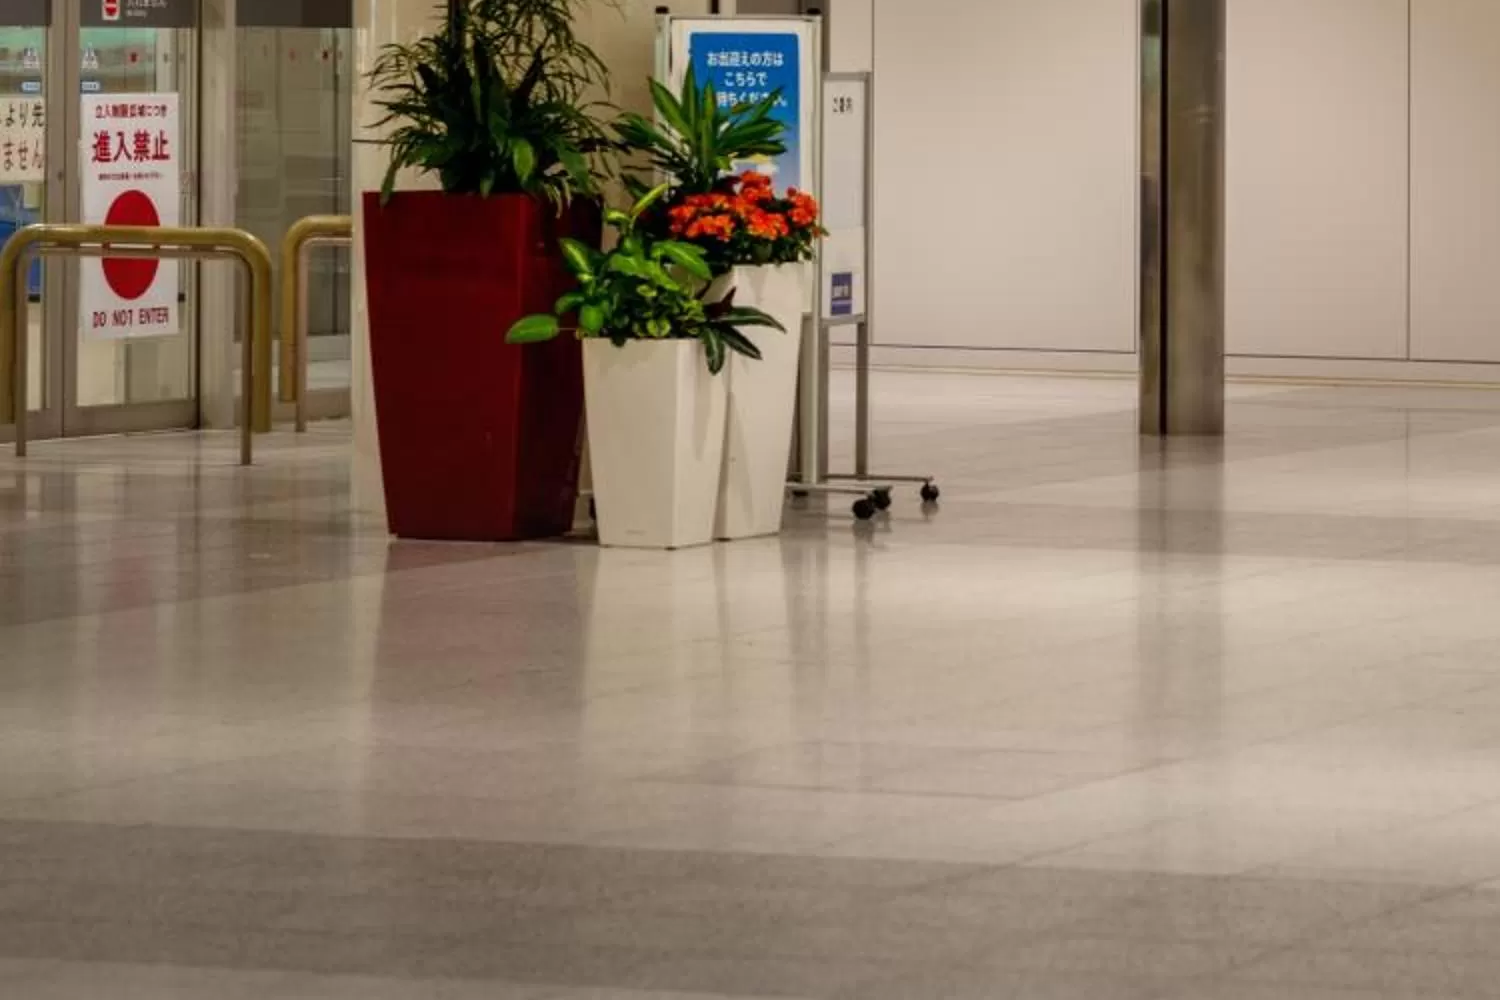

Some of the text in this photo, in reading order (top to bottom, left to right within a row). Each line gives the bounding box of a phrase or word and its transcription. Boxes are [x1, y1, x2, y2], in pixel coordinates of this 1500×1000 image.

[707, 51, 784, 67] お出迎えの方は
[724, 71, 768, 87] こちらで
[0, 101, 44, 128] より先
[92, 129, 170, 163] 進入禁止
[92, 306, 169, 328] DO NOT ENTER
